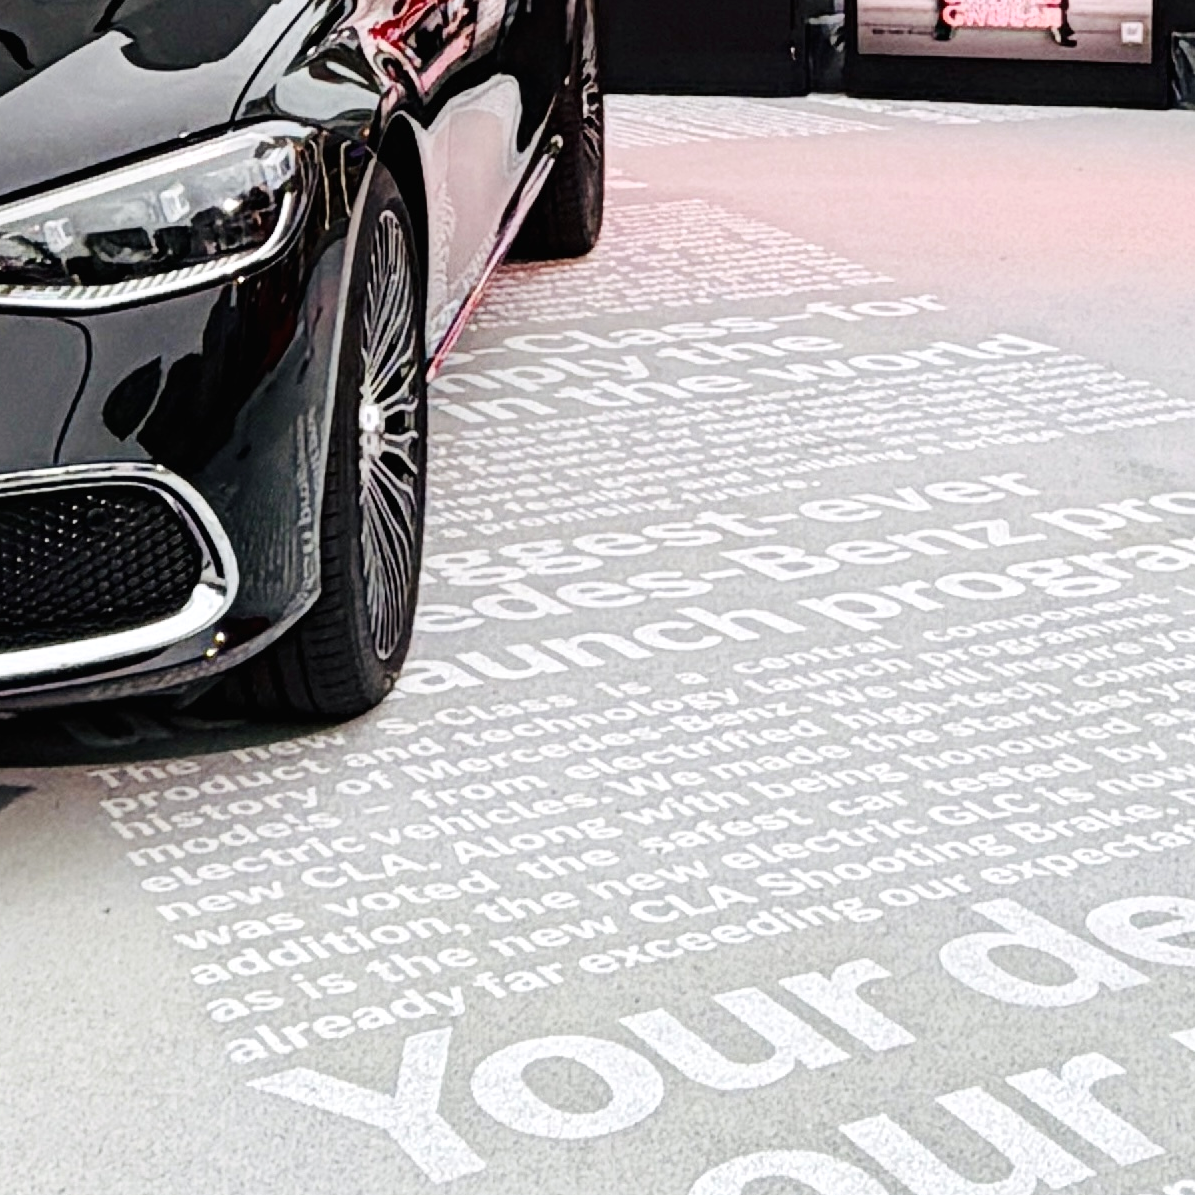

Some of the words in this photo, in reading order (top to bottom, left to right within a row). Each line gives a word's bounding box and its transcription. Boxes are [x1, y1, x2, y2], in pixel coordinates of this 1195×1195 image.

[427, 397, 557, 423] in
[553, 375, 754, 407] the
[749, 333, 1060, 382] world
[657, 334, 844, 365] the
[412, 519, 1048, 632] edes-Benz
[420, 471, 1041, 586] ggest-ever
[474, 498, 684, 534] promising
[677, 472, 752, 489] and
[88, 760, 201, 787] The
[232, 732, 354, 763] new
[377, 694, 577, 735] S-Class
[595, 682, 651, 698] is
[675, 673, 708, 684] a
[733, 636, 903, 674] central
[923, 593, 1170, 642] component
[100, 757, 341, 818] product
[343, 737, 445, 767] and
[452, 688, 739, 746] technology
[744, 658, 913, 694] launch
[917, 614, 1174, 668] programme
[112, 786, 331, 838] history
[336, 770, 393, 795] of
[401, 702, 813, 782] Mercedes-Benz.
[805, 686, 897, 706] We
[899, 667, 993, 692] will
[983, 642, 1144, 677] inspire
[384, 603, 805, 699] aunch
[411, 776, 550, 808] from
[565, 720, 828, 779] electrified
[831, 682, 1061, 729] high-tech
[141, 836, 367, 892] electric
[369, 793, 613, 845] vehicles.
[604, 772, 707, 796] We
[708, 745, 852, 780] made
[850, 720, 939, 752] the
[942, 706, 1062, 736] start
[1051, 690, 1153, 716] last
[156, 881, 284, 922] new
[301, 854, 441, 888] CLA.
[453, 817, 623, 864] Along
[621, 791, 750, 825] with
[747, 763, 909, 800] being
[899, 717, 1141, 771] honoured
[173, 913, 305, 949] was
[322, 870, 500, 917] voted
[516, 850, 620, 879] the
[639, 807, 814, 854] safest
[827, 790, 908, 816] car
[923, 753, 1093, 796] tested
[1095, 741, 1167, 762] by
[191, 918, 471, 985] addition,
[473, 892, 580, 922] the
[587, 860, 710, 900] new
[721, 818, 928, 870] electric
[927, 794, 1041, 825] GLC
[1034, 787, 1095, 806] is
[206, 990, 284, 1022] as
[292, 973, 357, 999] is
[365, 948, 478, 982] the
[489, 916, 618, 956] new
[629, 885, 758, 923] CLA
[755, 834, 1017, 896] Shooting
[1004, 805, 1179, 844] Brake.
[222, 986, 465, 1064] already
[473, 962, 564, 998] far
[579, 897, 883, 973] exceeding
[879, 874, 971, 906] our
[247, 958, 917, 1185] Your
